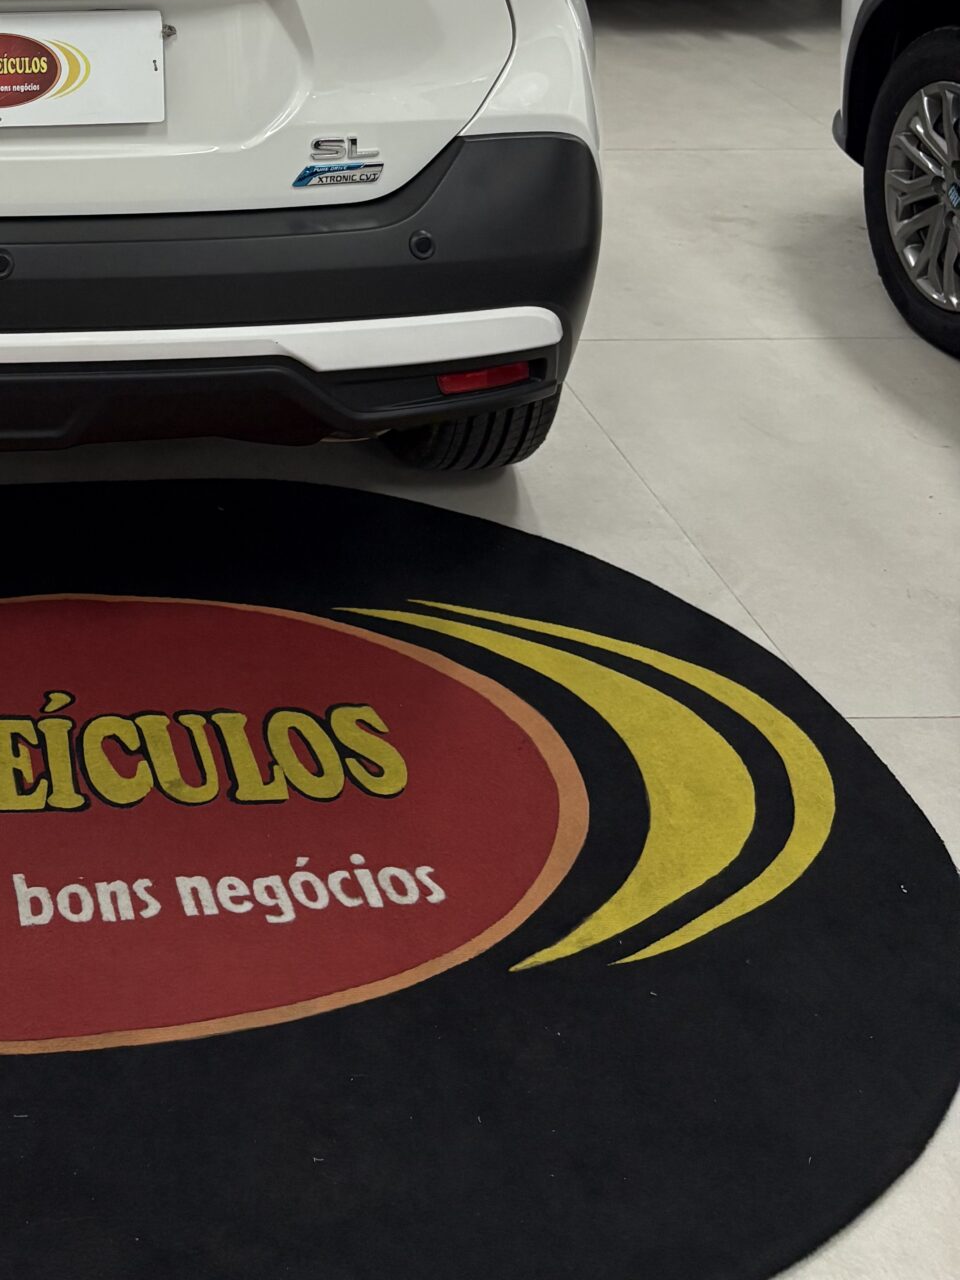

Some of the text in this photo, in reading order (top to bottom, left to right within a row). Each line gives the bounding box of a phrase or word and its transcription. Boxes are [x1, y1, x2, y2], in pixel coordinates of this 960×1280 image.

[310, 136, 380, 160] SL
[317, 173, 378, 183] XTRONIC CVT
[12, 873, 162, 927] bons
[175, 853, 446, 923] negócios
